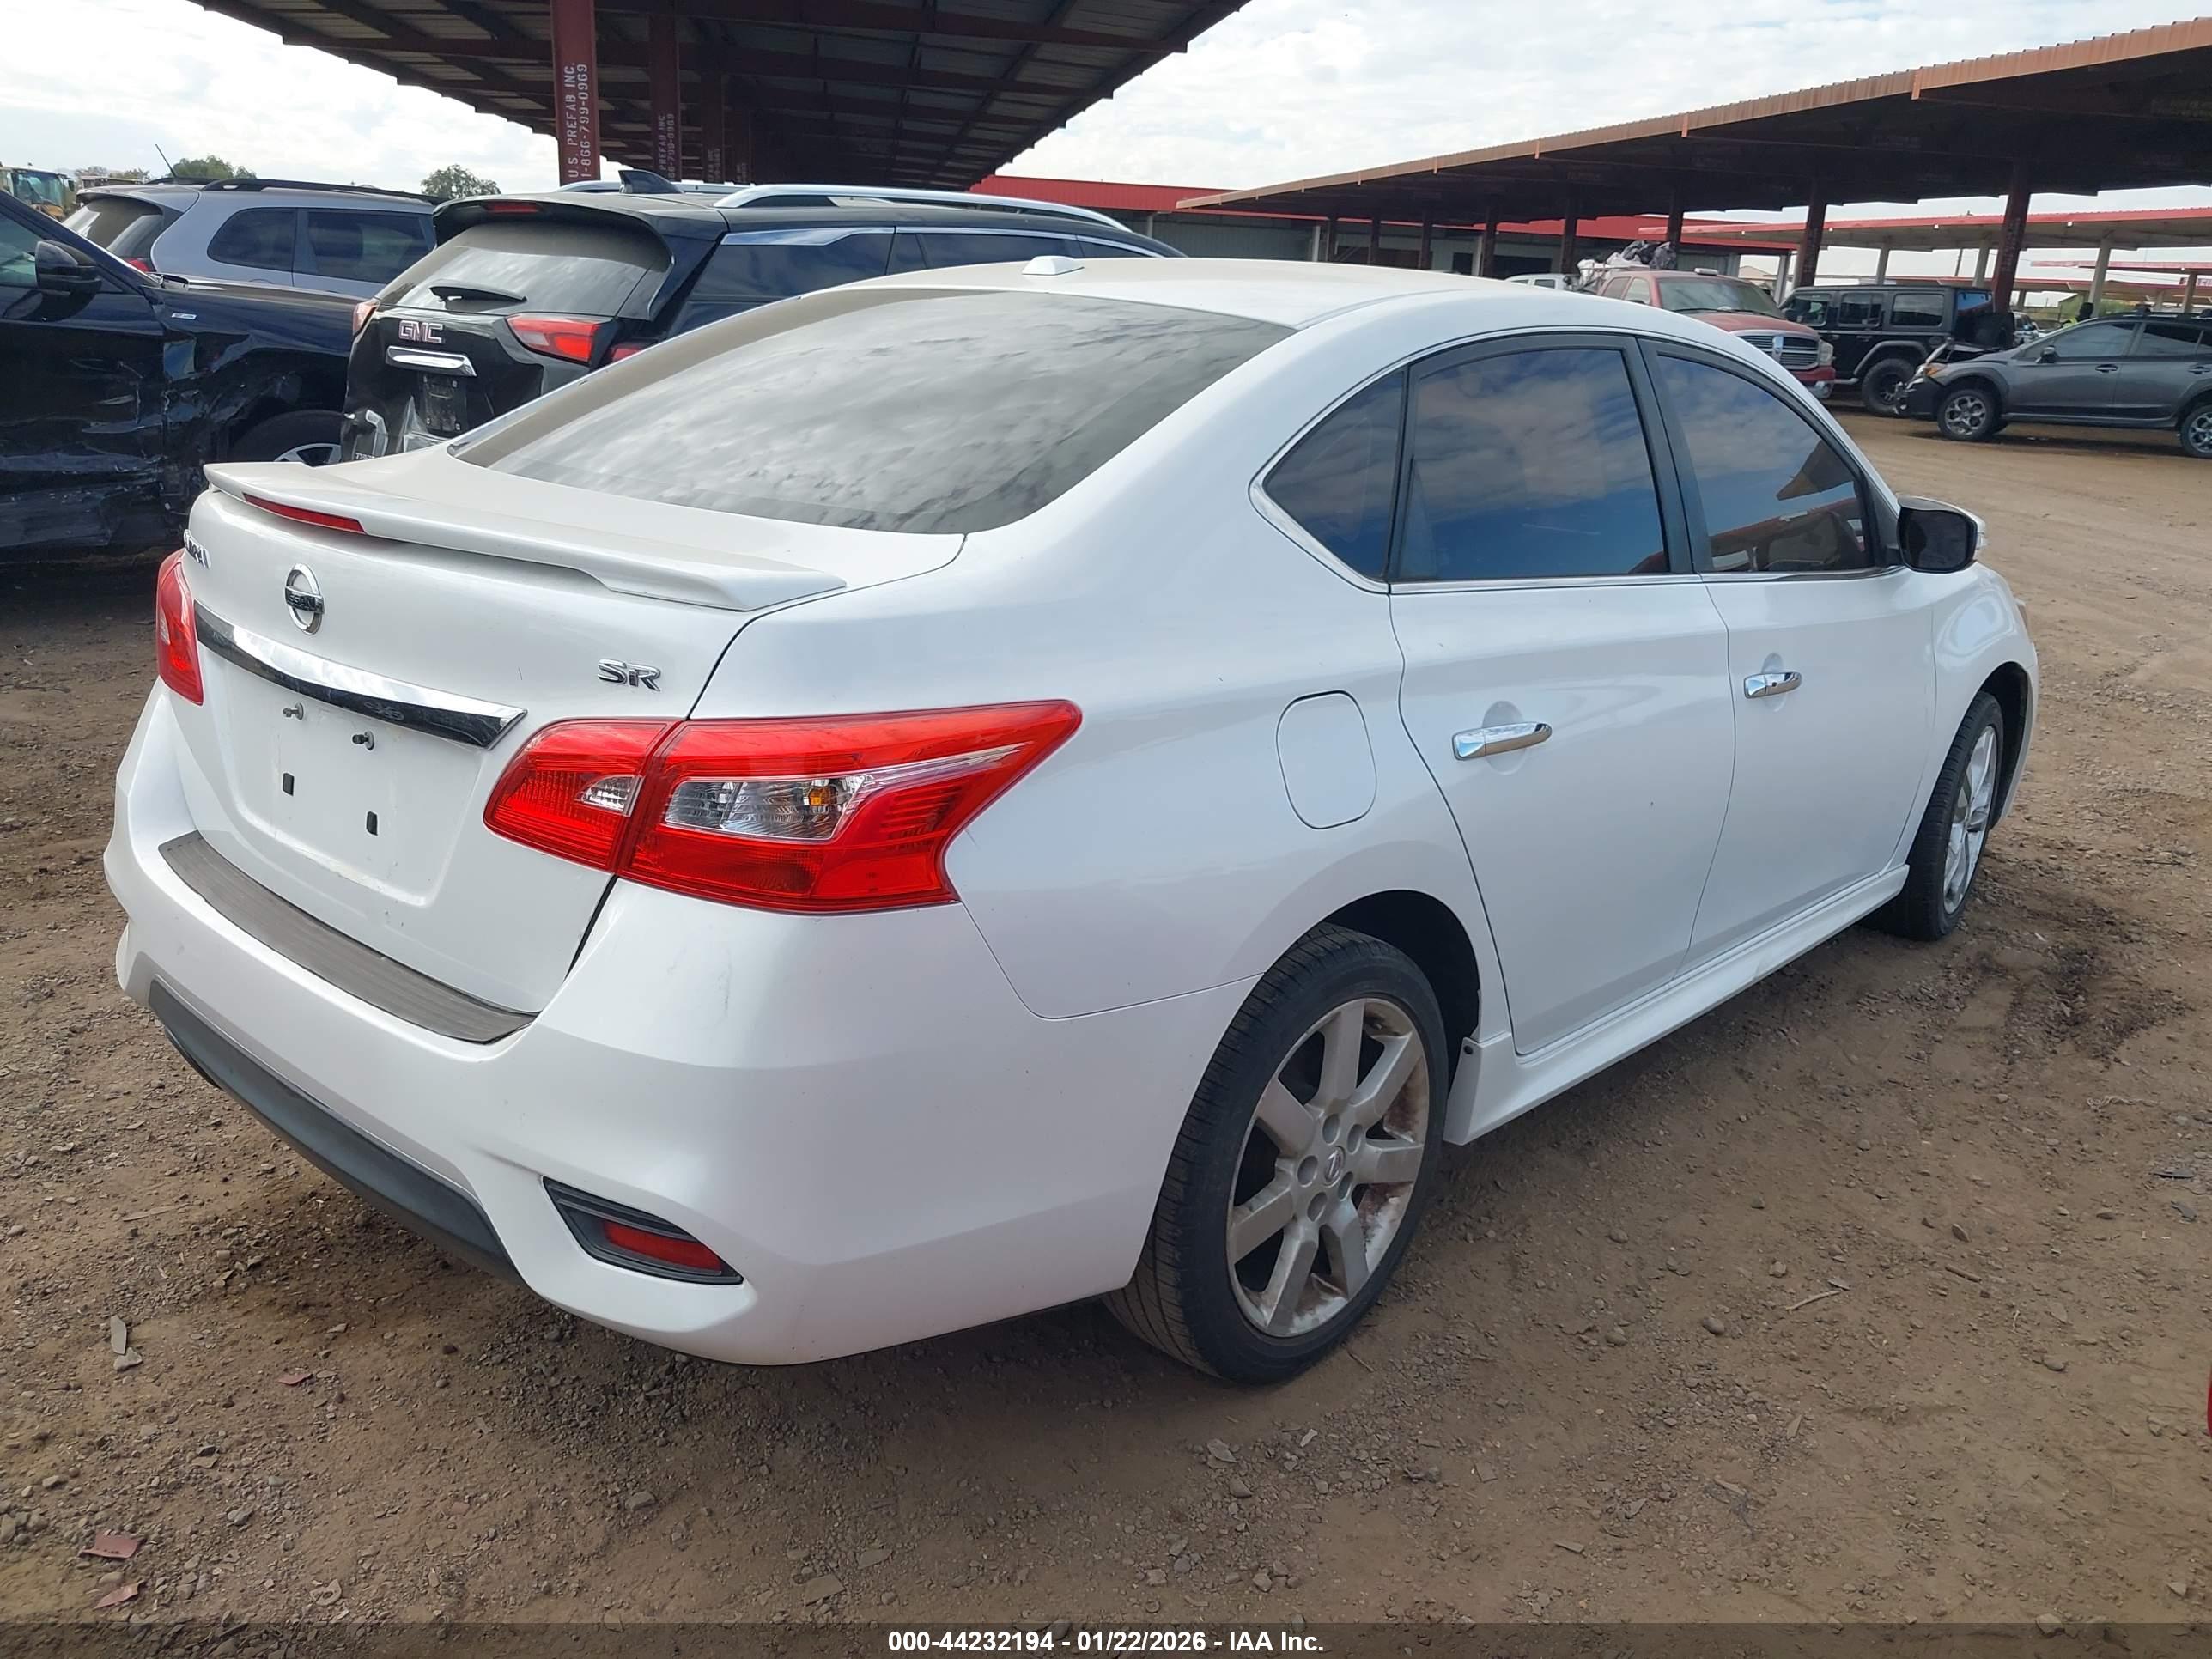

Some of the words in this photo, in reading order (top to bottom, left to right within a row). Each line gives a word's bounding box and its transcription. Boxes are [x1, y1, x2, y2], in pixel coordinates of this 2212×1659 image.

[563, 63, 576, 88] INC.
[565, 94, 578, 146] PREFAB
[576, 64, 592, 177] 1-866-799-0969
[567, 153, 579, 178] U.S.
[398, 319, 446, 344] GMC
[598, 658, 661, 692] SR
